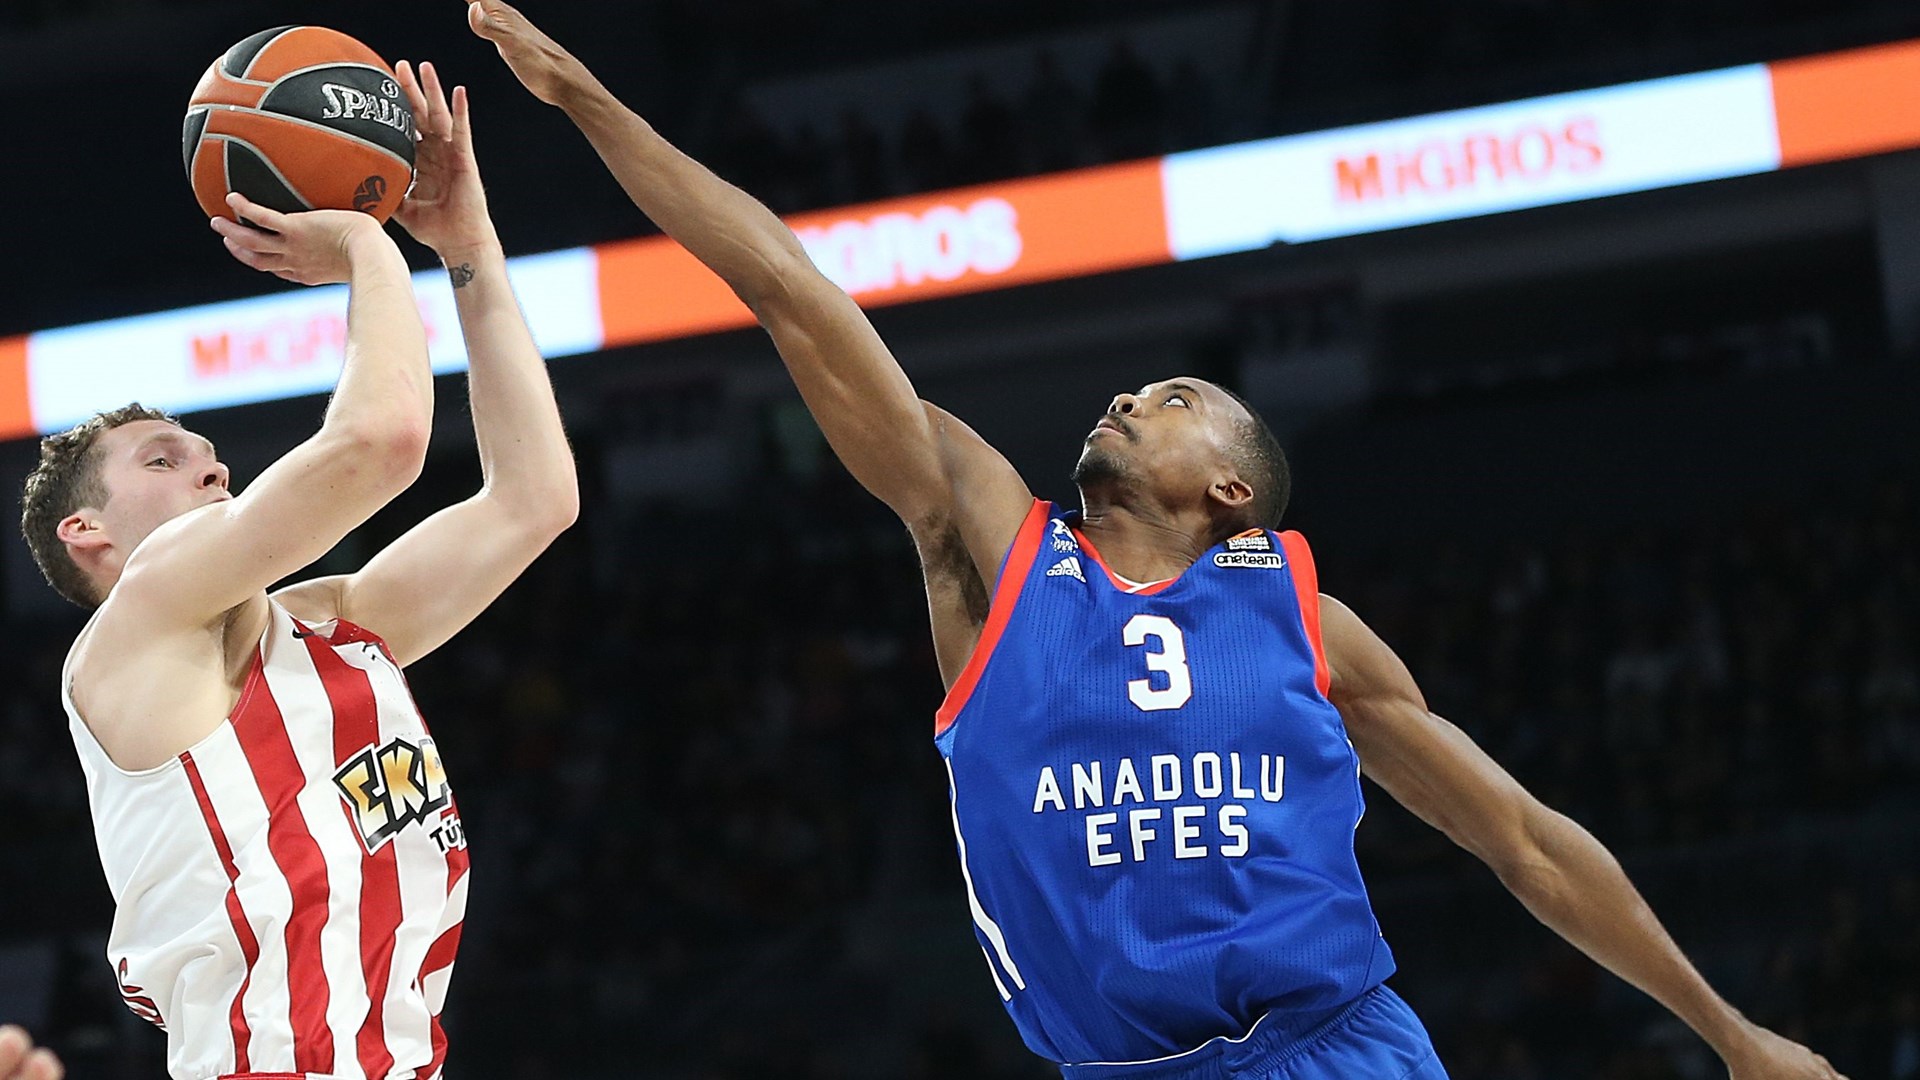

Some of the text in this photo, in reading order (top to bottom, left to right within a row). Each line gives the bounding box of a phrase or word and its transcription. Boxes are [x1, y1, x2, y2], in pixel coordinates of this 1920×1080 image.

[321, 82, 416, 142] SPALDI
[1046, 567, 1087, 583] adidas
[1216, 553, 1280, 566] oneteam
[1122, 614, 1192, 711] 3
[1033, 752, 1284, 813] ANADOLU
[1085, 804, 1249, 867] EFES
